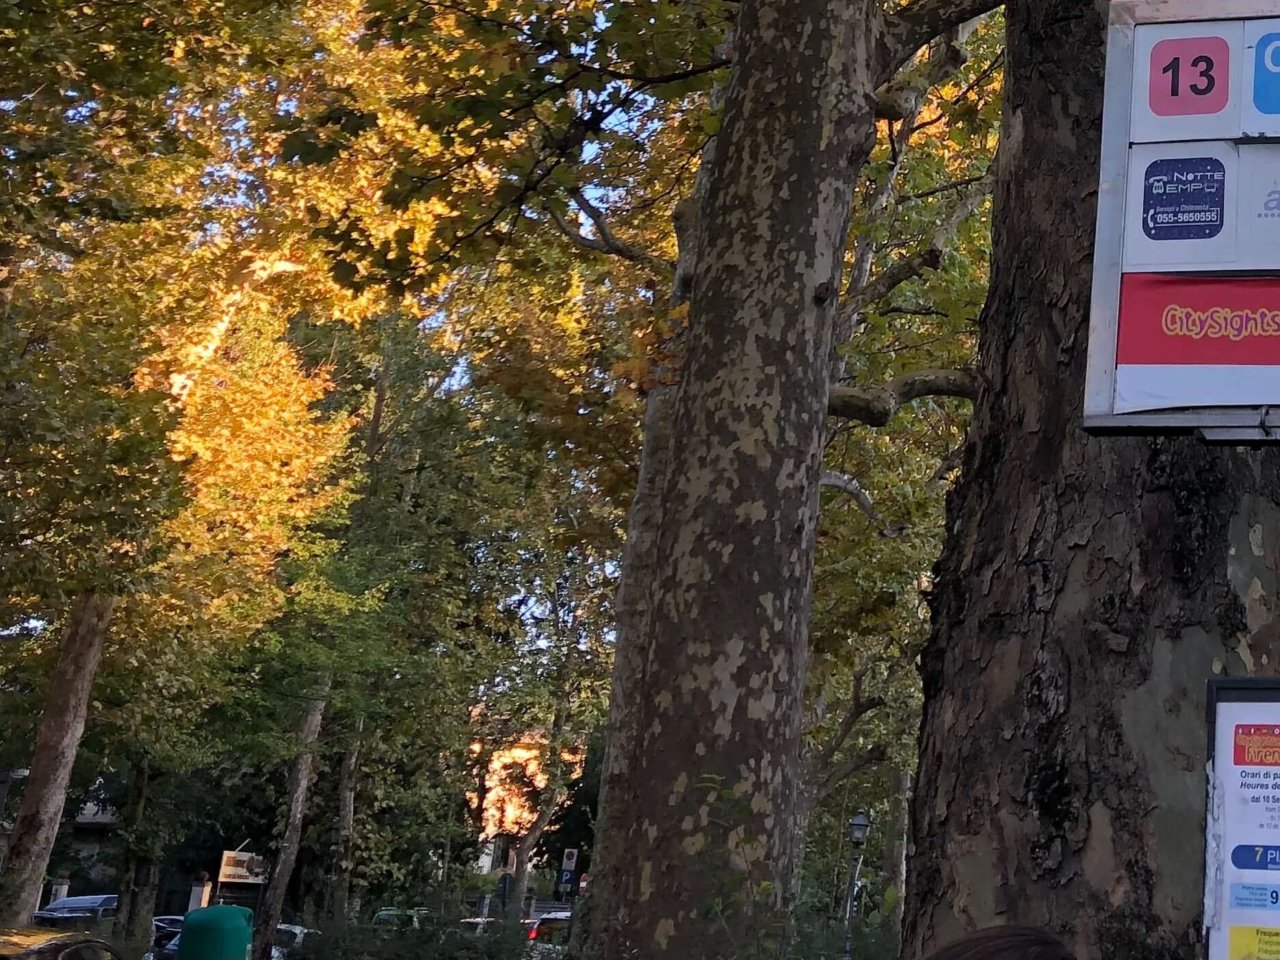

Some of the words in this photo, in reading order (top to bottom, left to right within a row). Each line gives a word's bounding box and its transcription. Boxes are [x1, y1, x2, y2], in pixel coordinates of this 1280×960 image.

[1161, 56, 1215, 97] 13
[1240, 770, 1261, 779] Orari
[1263, 770, 1271, 779] di
[1240, 781, 1269, 790] Heures
[1254, 847, 1264, 862] 7
